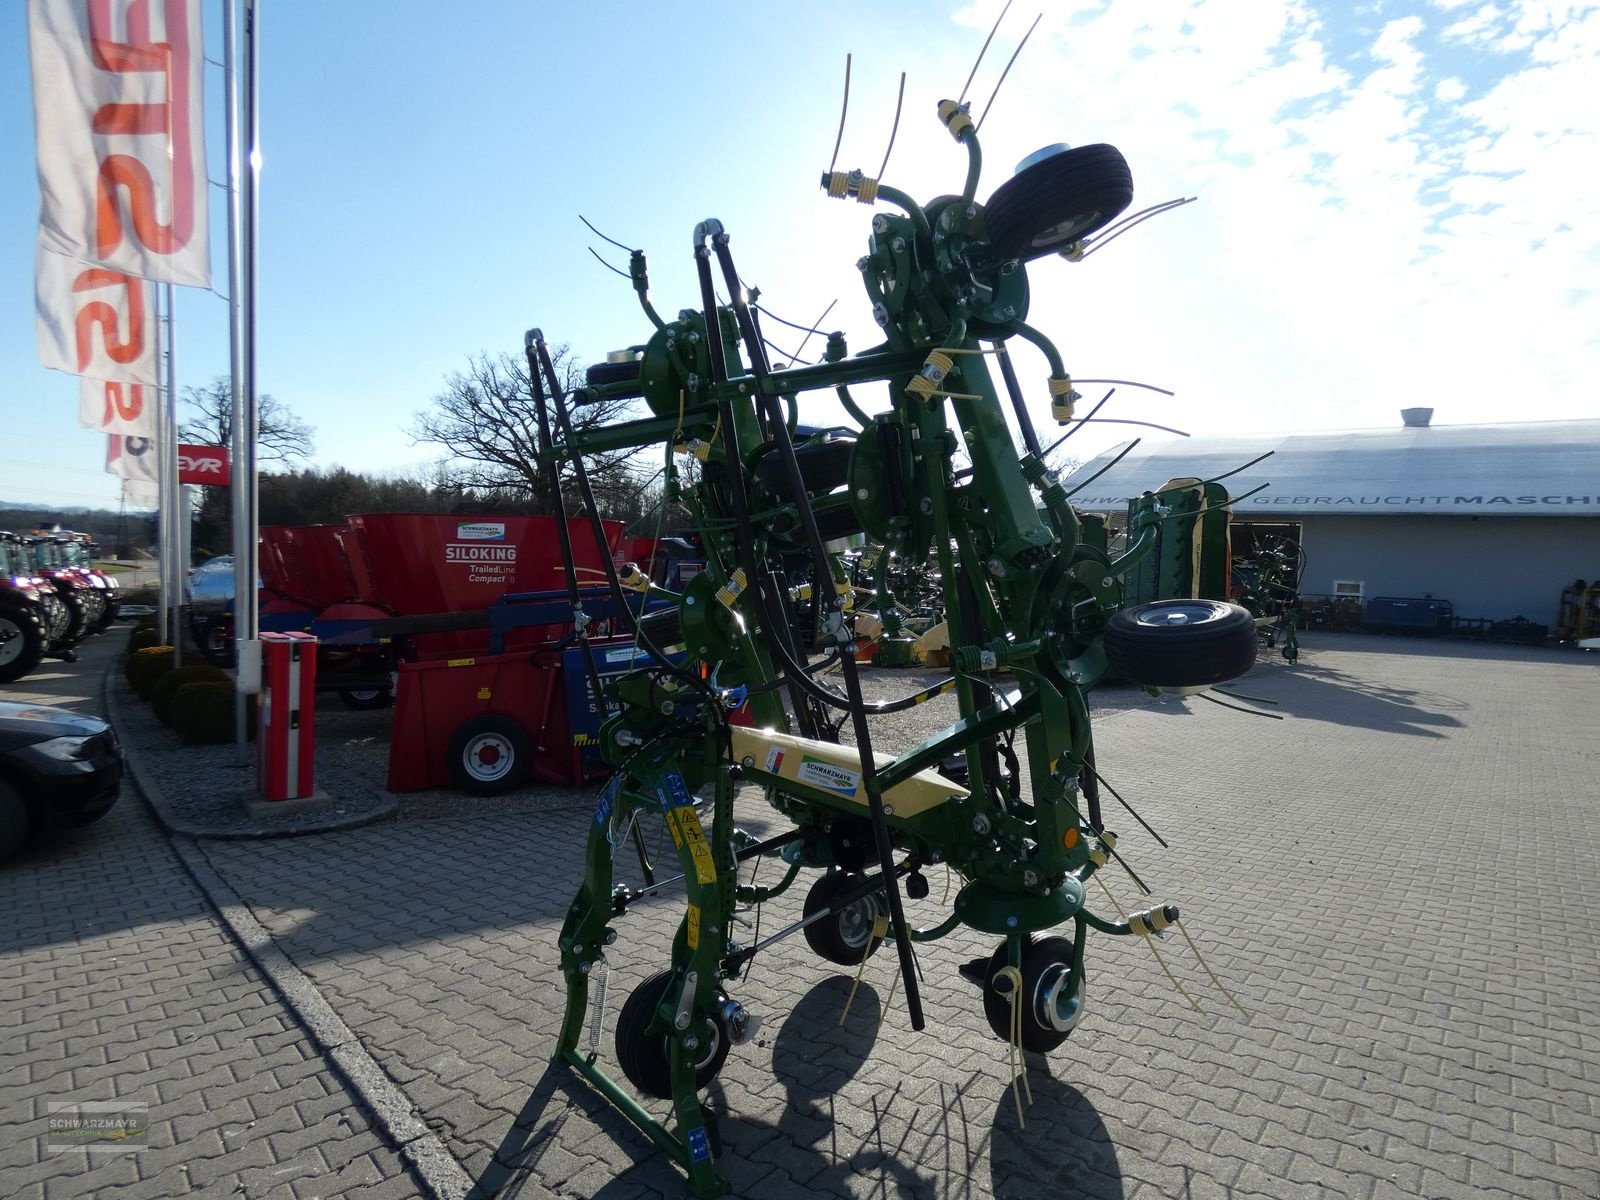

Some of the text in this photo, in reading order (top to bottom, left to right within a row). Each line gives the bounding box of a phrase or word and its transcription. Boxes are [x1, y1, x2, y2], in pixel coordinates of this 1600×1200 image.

[178, 455, 223, 474] EYR
[446, 548, 516, 560] SILOKING
[469, 564, 516, 574] TrailedLine
[468, 574, 506, 584] Compact
[806, 763, 851, 782] SCHWARZMAYR
